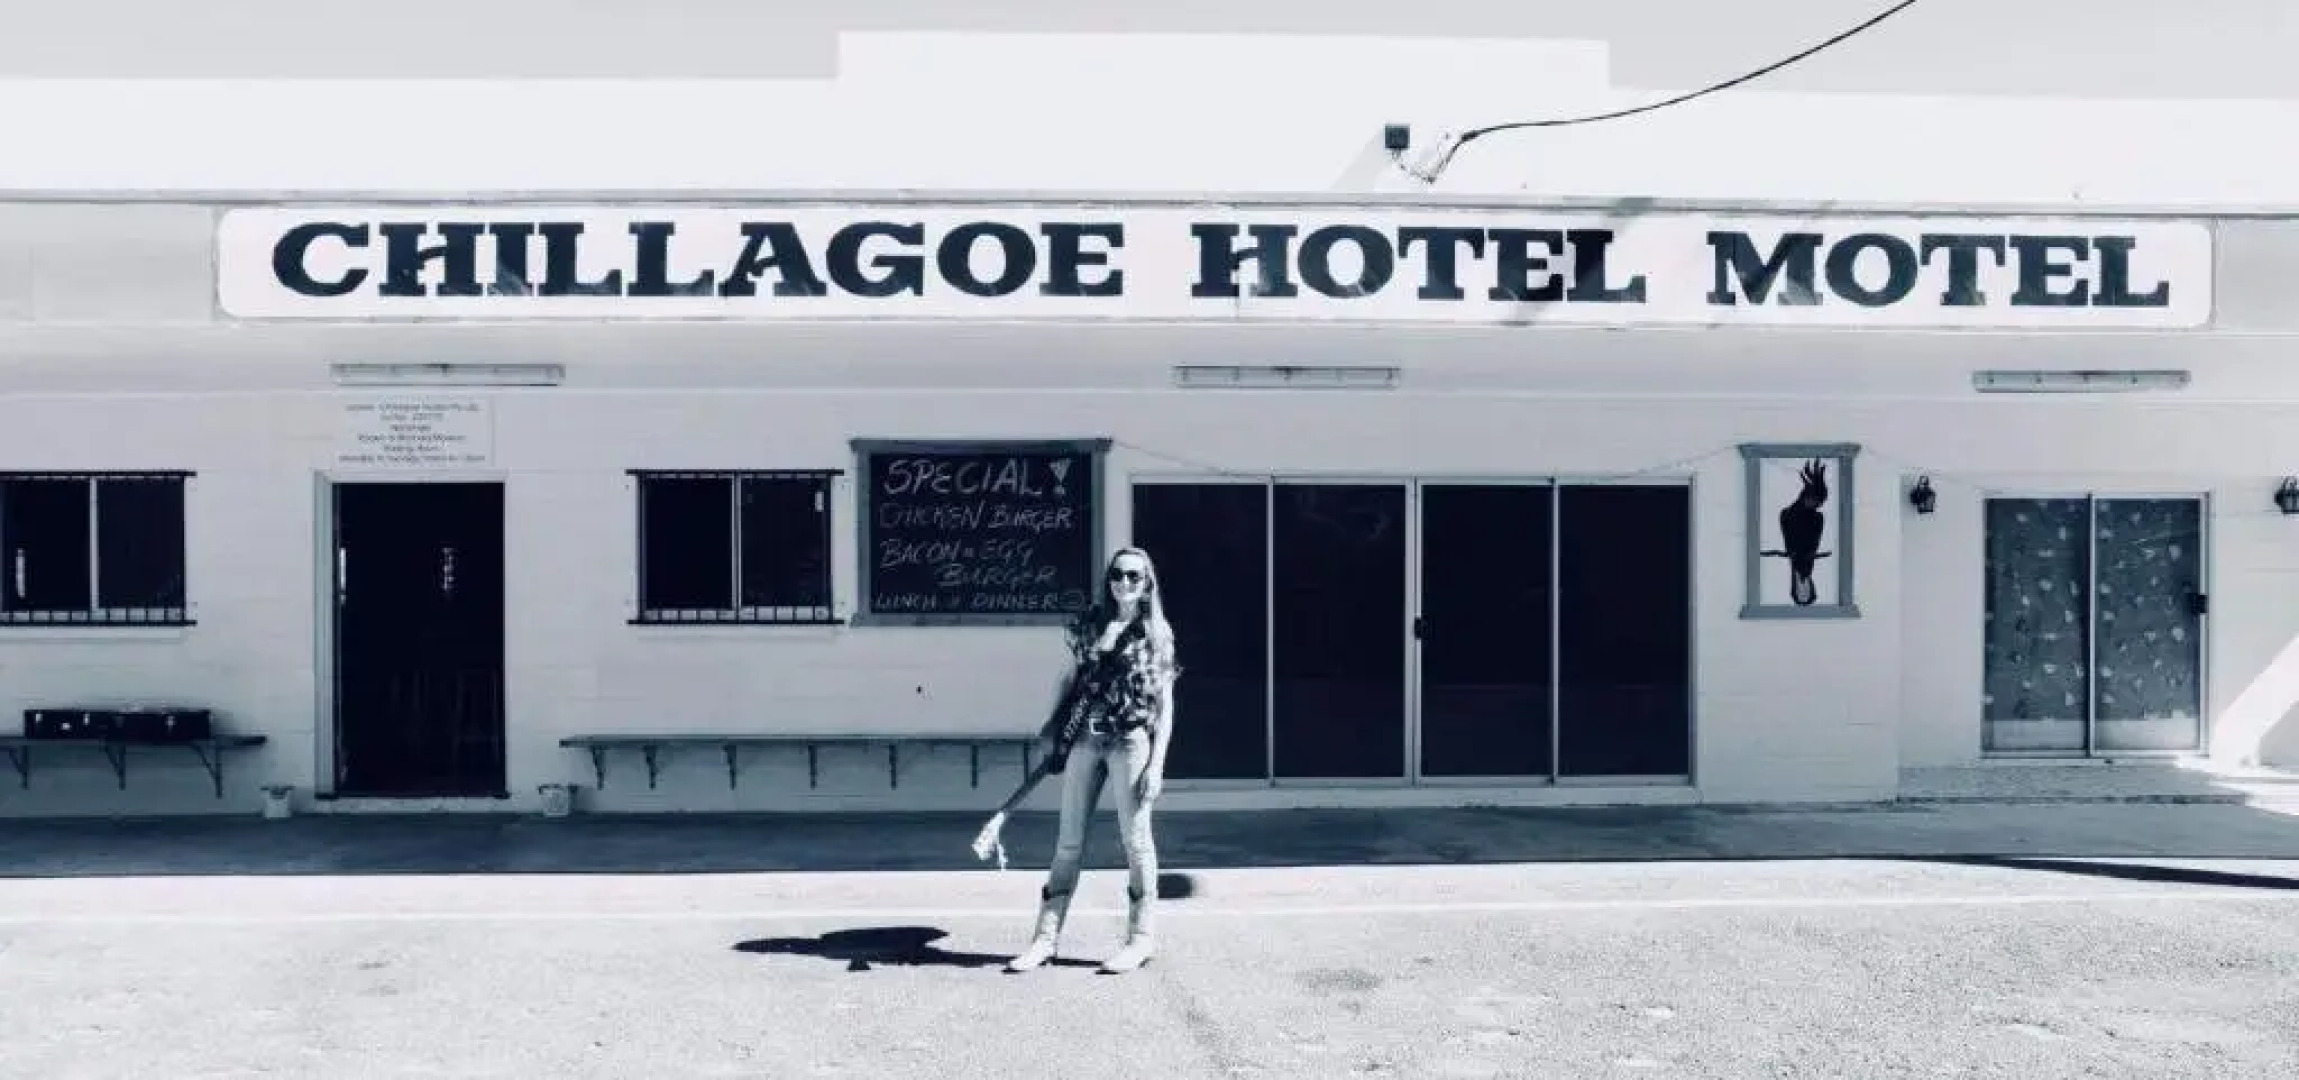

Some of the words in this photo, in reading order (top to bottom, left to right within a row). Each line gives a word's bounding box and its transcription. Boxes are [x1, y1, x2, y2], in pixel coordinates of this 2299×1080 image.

[272, 221, 1124, 298] CHILLAGOE
[1191, 223, 1646, 304] HOTEL
[1707, 230, 2170, 307] MOTEL
[879, 501, 985, 529] CHICKEN
[879, 538, 961, 569] BACON
